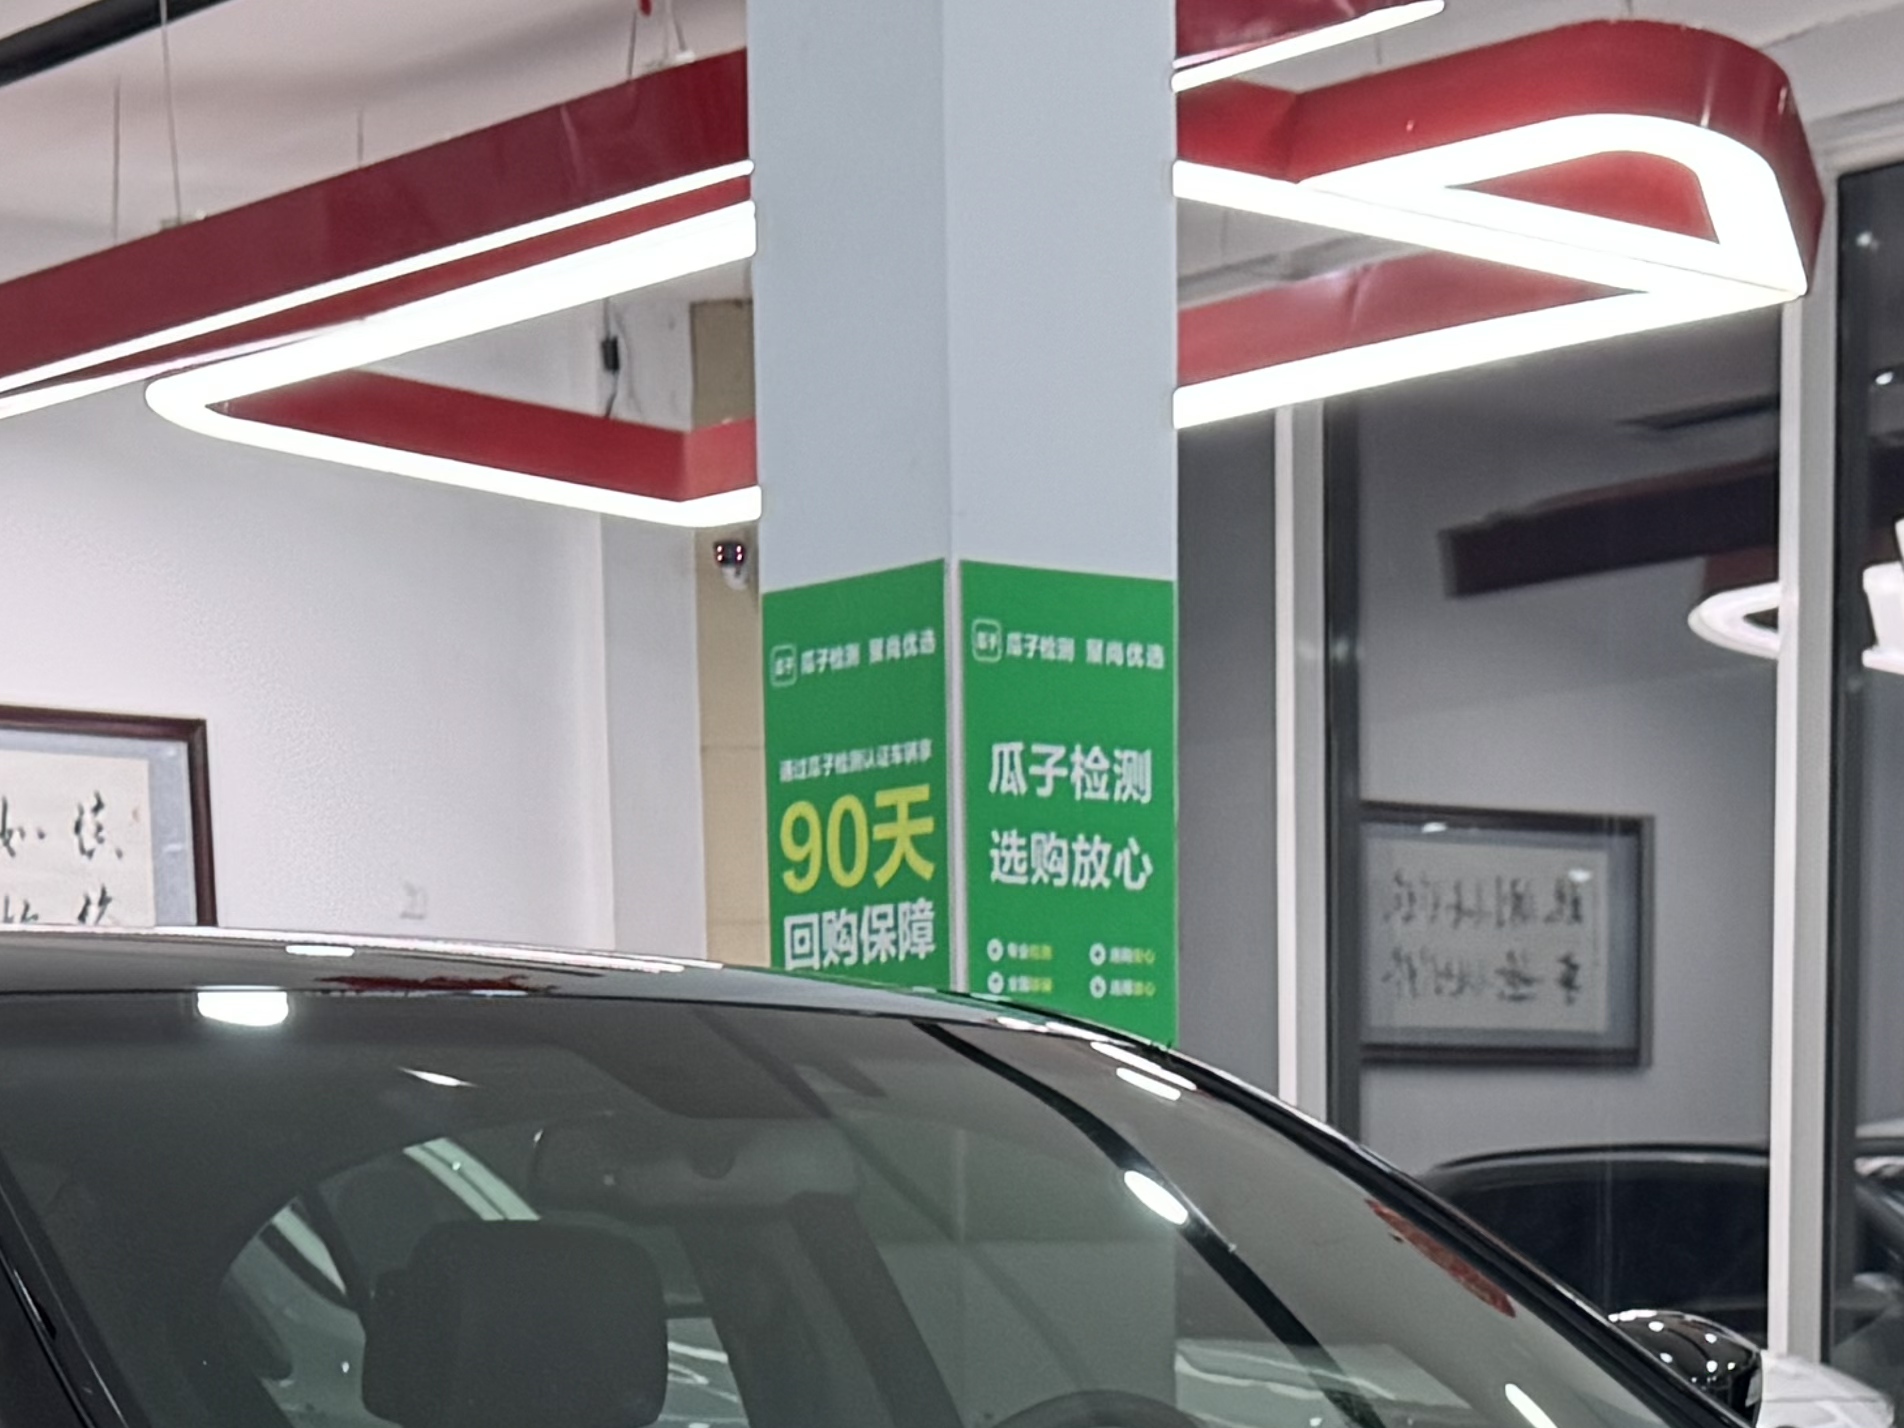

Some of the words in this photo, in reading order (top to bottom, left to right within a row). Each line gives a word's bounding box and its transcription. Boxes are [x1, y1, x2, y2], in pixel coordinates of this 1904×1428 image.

[988, 742, 1153, 804] 瓜子检测
[779, 783, 936, 893] 90天
[989, 828, 1153, 891] 选购放心
[783, 897, 937, 970] 回购保障
